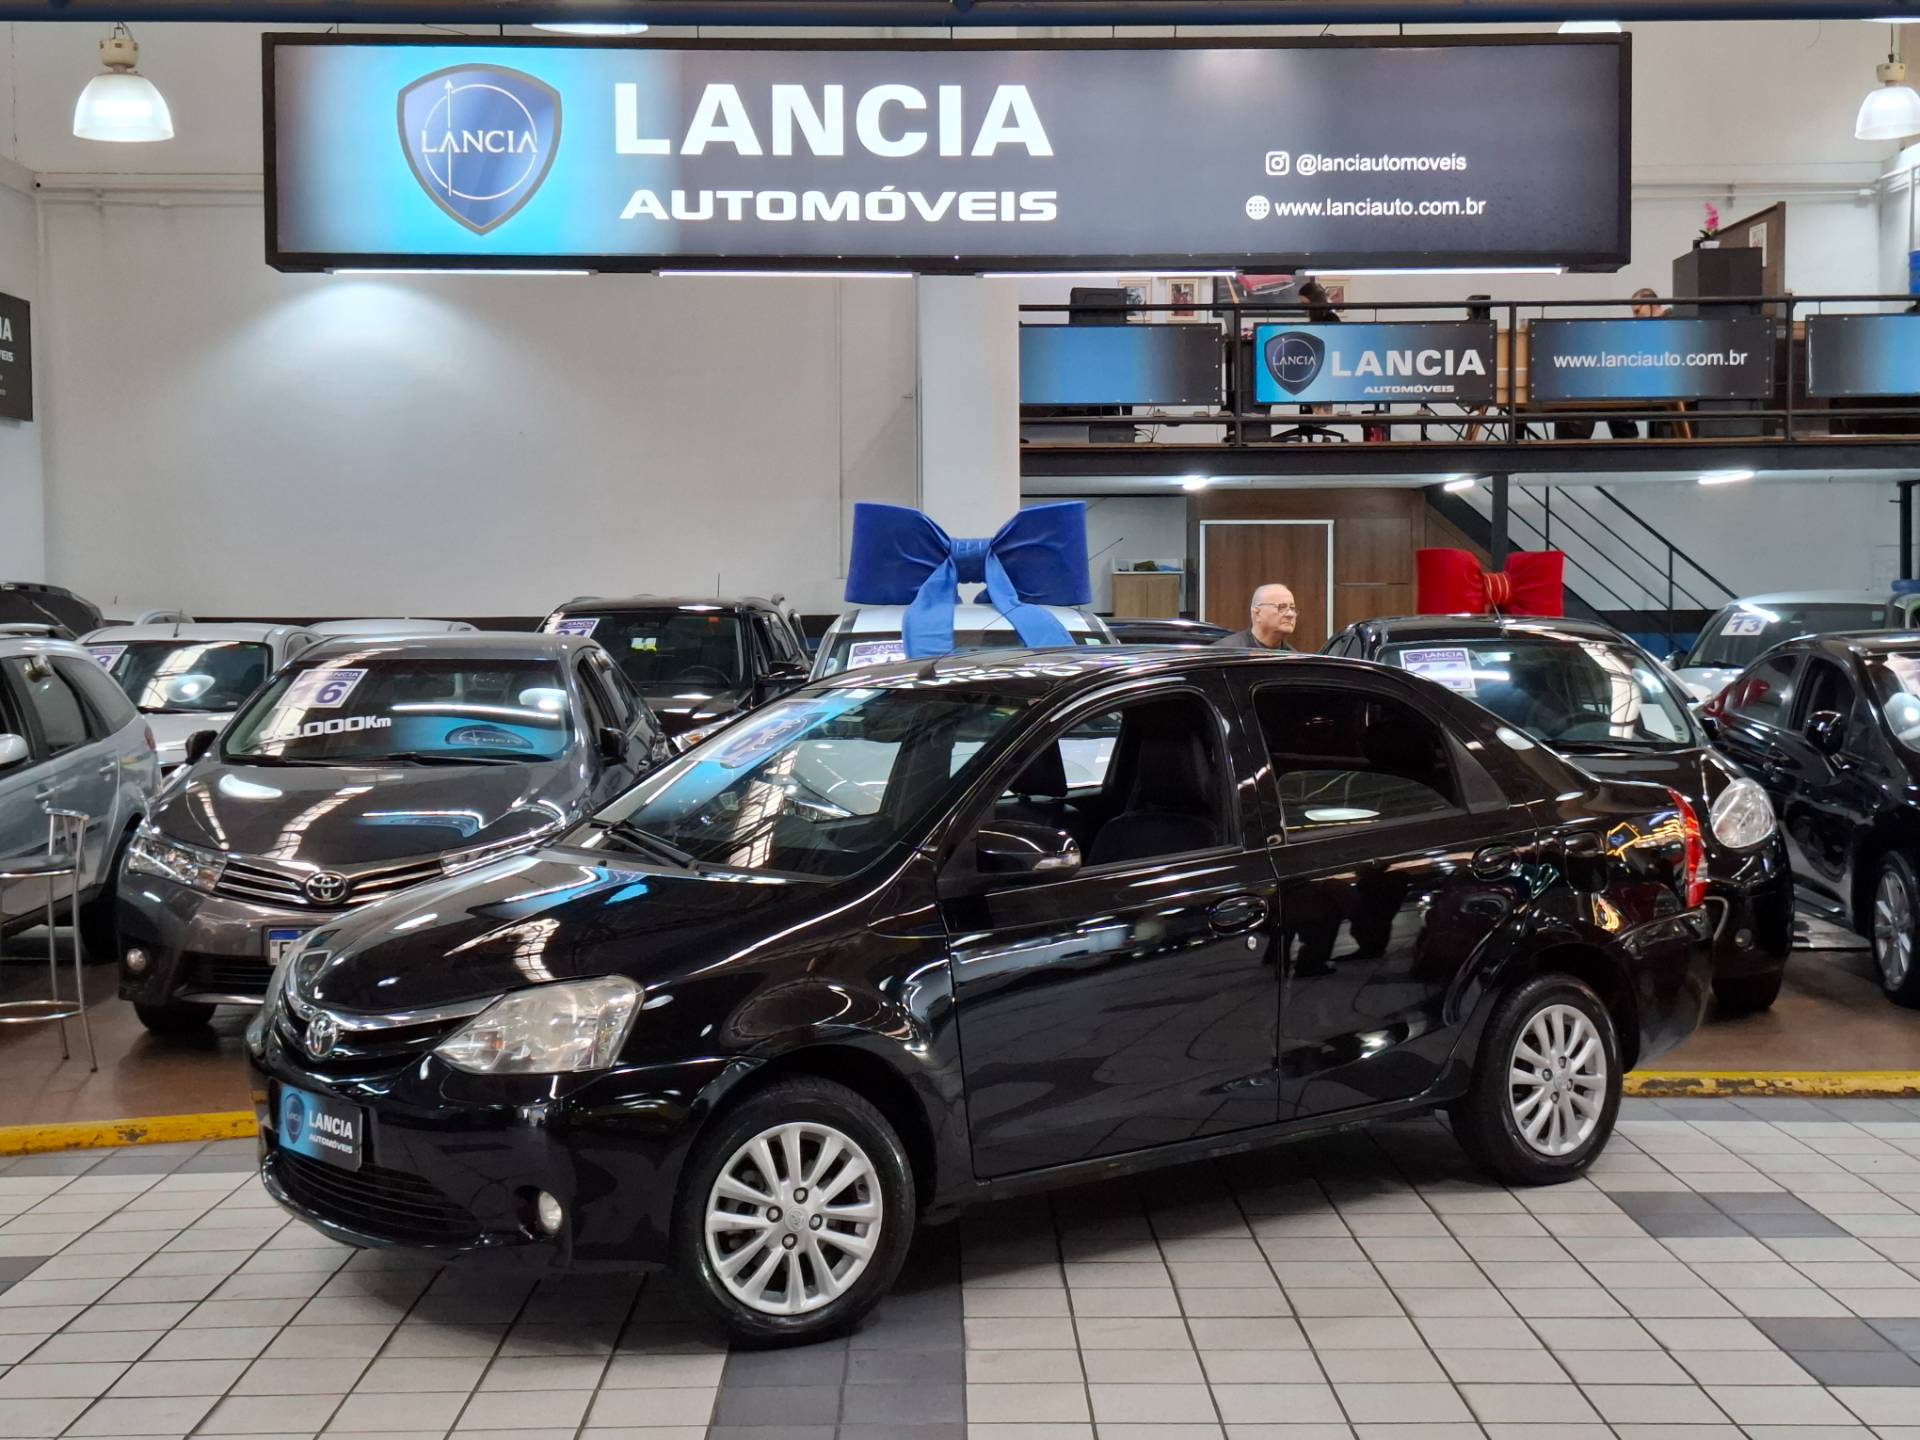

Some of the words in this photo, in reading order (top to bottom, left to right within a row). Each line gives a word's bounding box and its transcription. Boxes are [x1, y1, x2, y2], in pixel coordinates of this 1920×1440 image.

[614, 83, 1055, 157] LANCIA
[421, 130, 538, 153] LANCIA
[1296, 153, 1467, 175] @lanciautomoveis
[619, 185, 1058, 222] AUTOMÓVEIS
[1275, 198, 1487, 216] www.lanciauto.com.br
[1272, 355, 1316, 366] LANCIA
[1331, 349, 1487, 376] LANCIA
[1553, 349, 1748, 368] www.lanciauto.com.br
[309, 1110, 353, 1139] LANCIA
